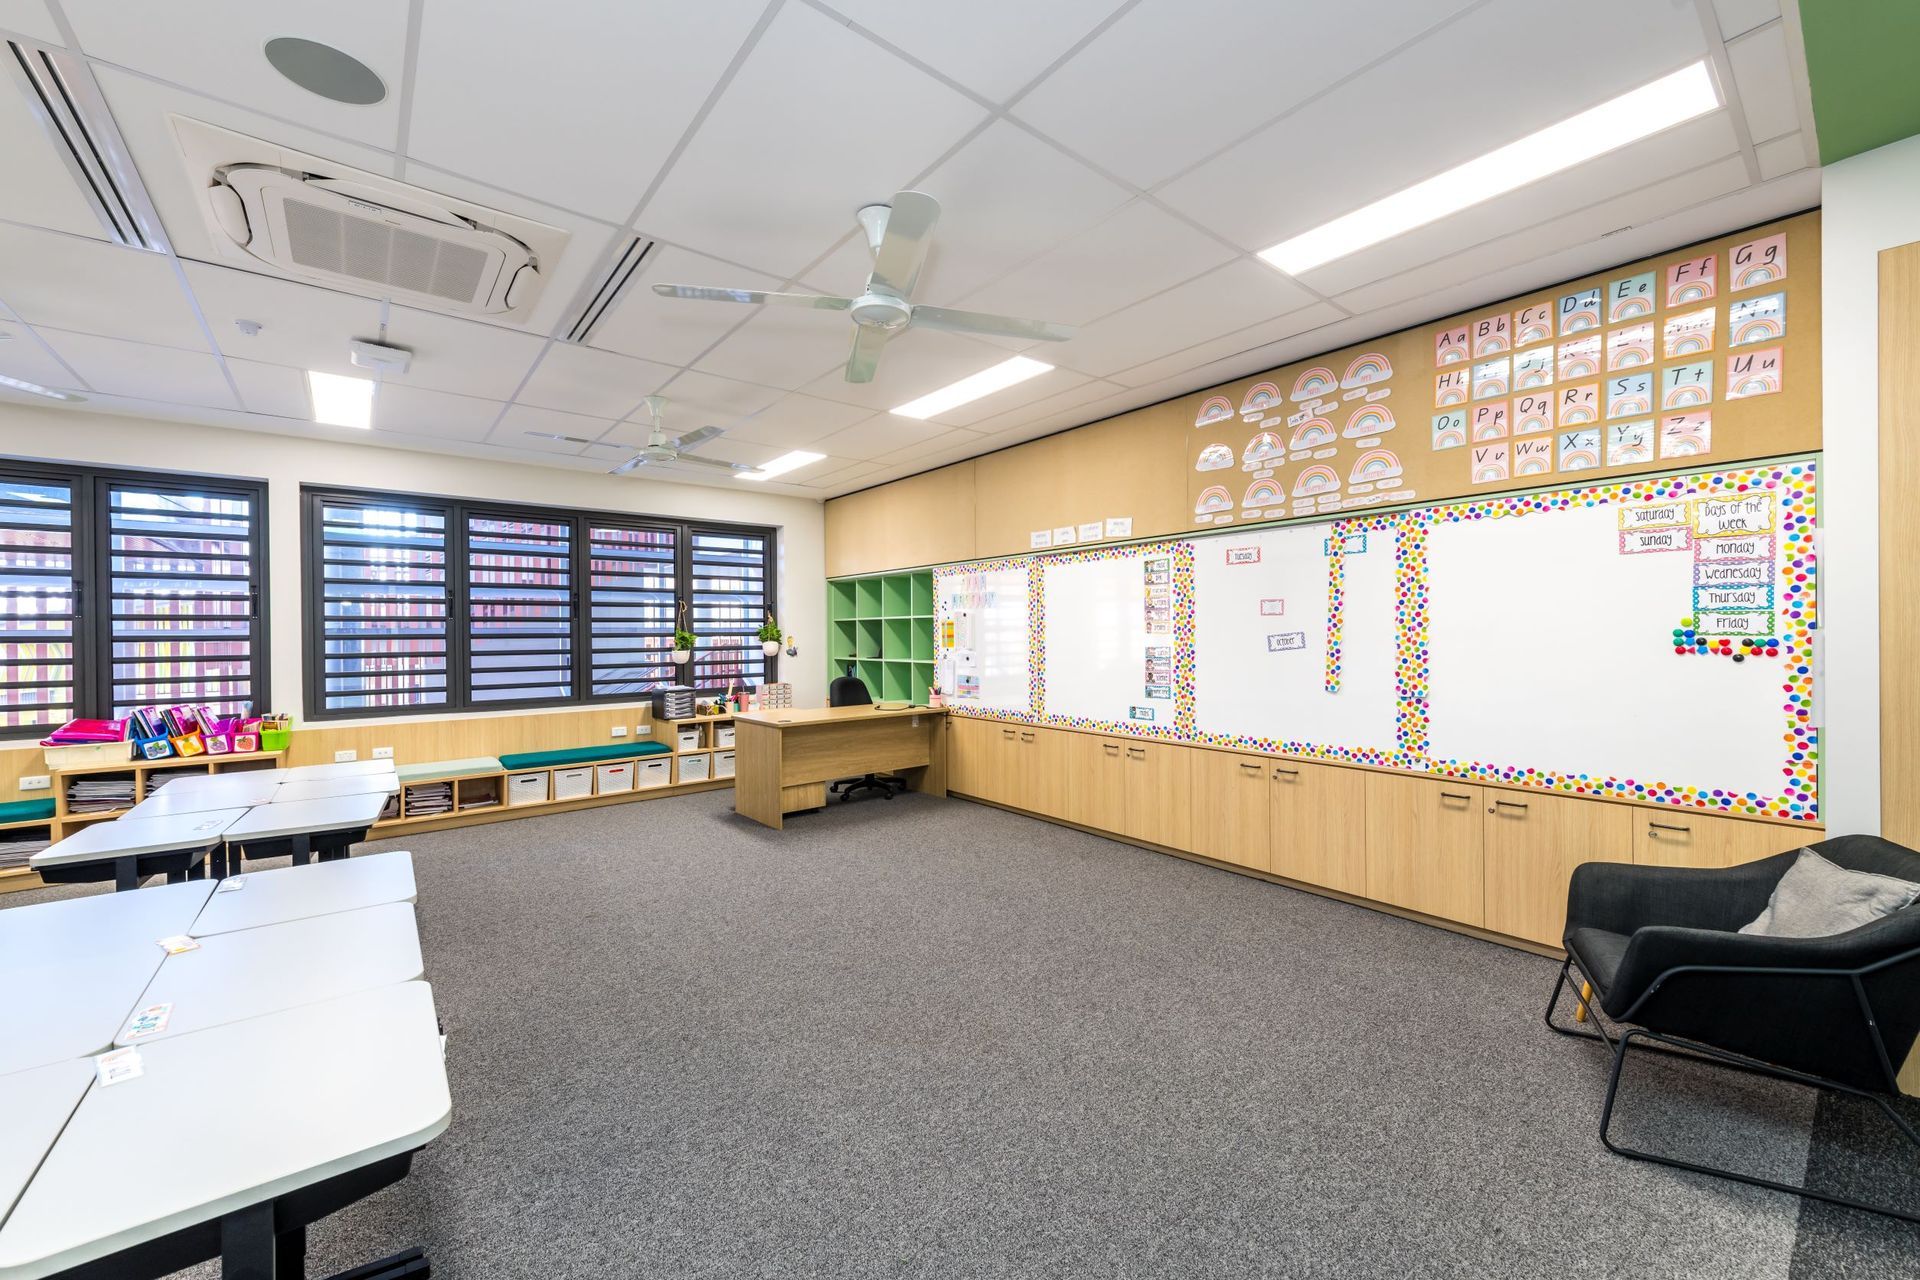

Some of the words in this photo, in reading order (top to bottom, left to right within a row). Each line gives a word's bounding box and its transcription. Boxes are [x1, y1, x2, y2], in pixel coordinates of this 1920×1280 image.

[1705, 504, 1726, 517] Days
[1730, 502, 1743, 514] of
[1745, 501, 1762, 514] the
[1716, 542, 1755, 554] Monday
[1705, 567, 1761, 580] Wednesday
[1709, 592, 1756, 604] Thursday
[1716, 617, 1749, 630] Friday
